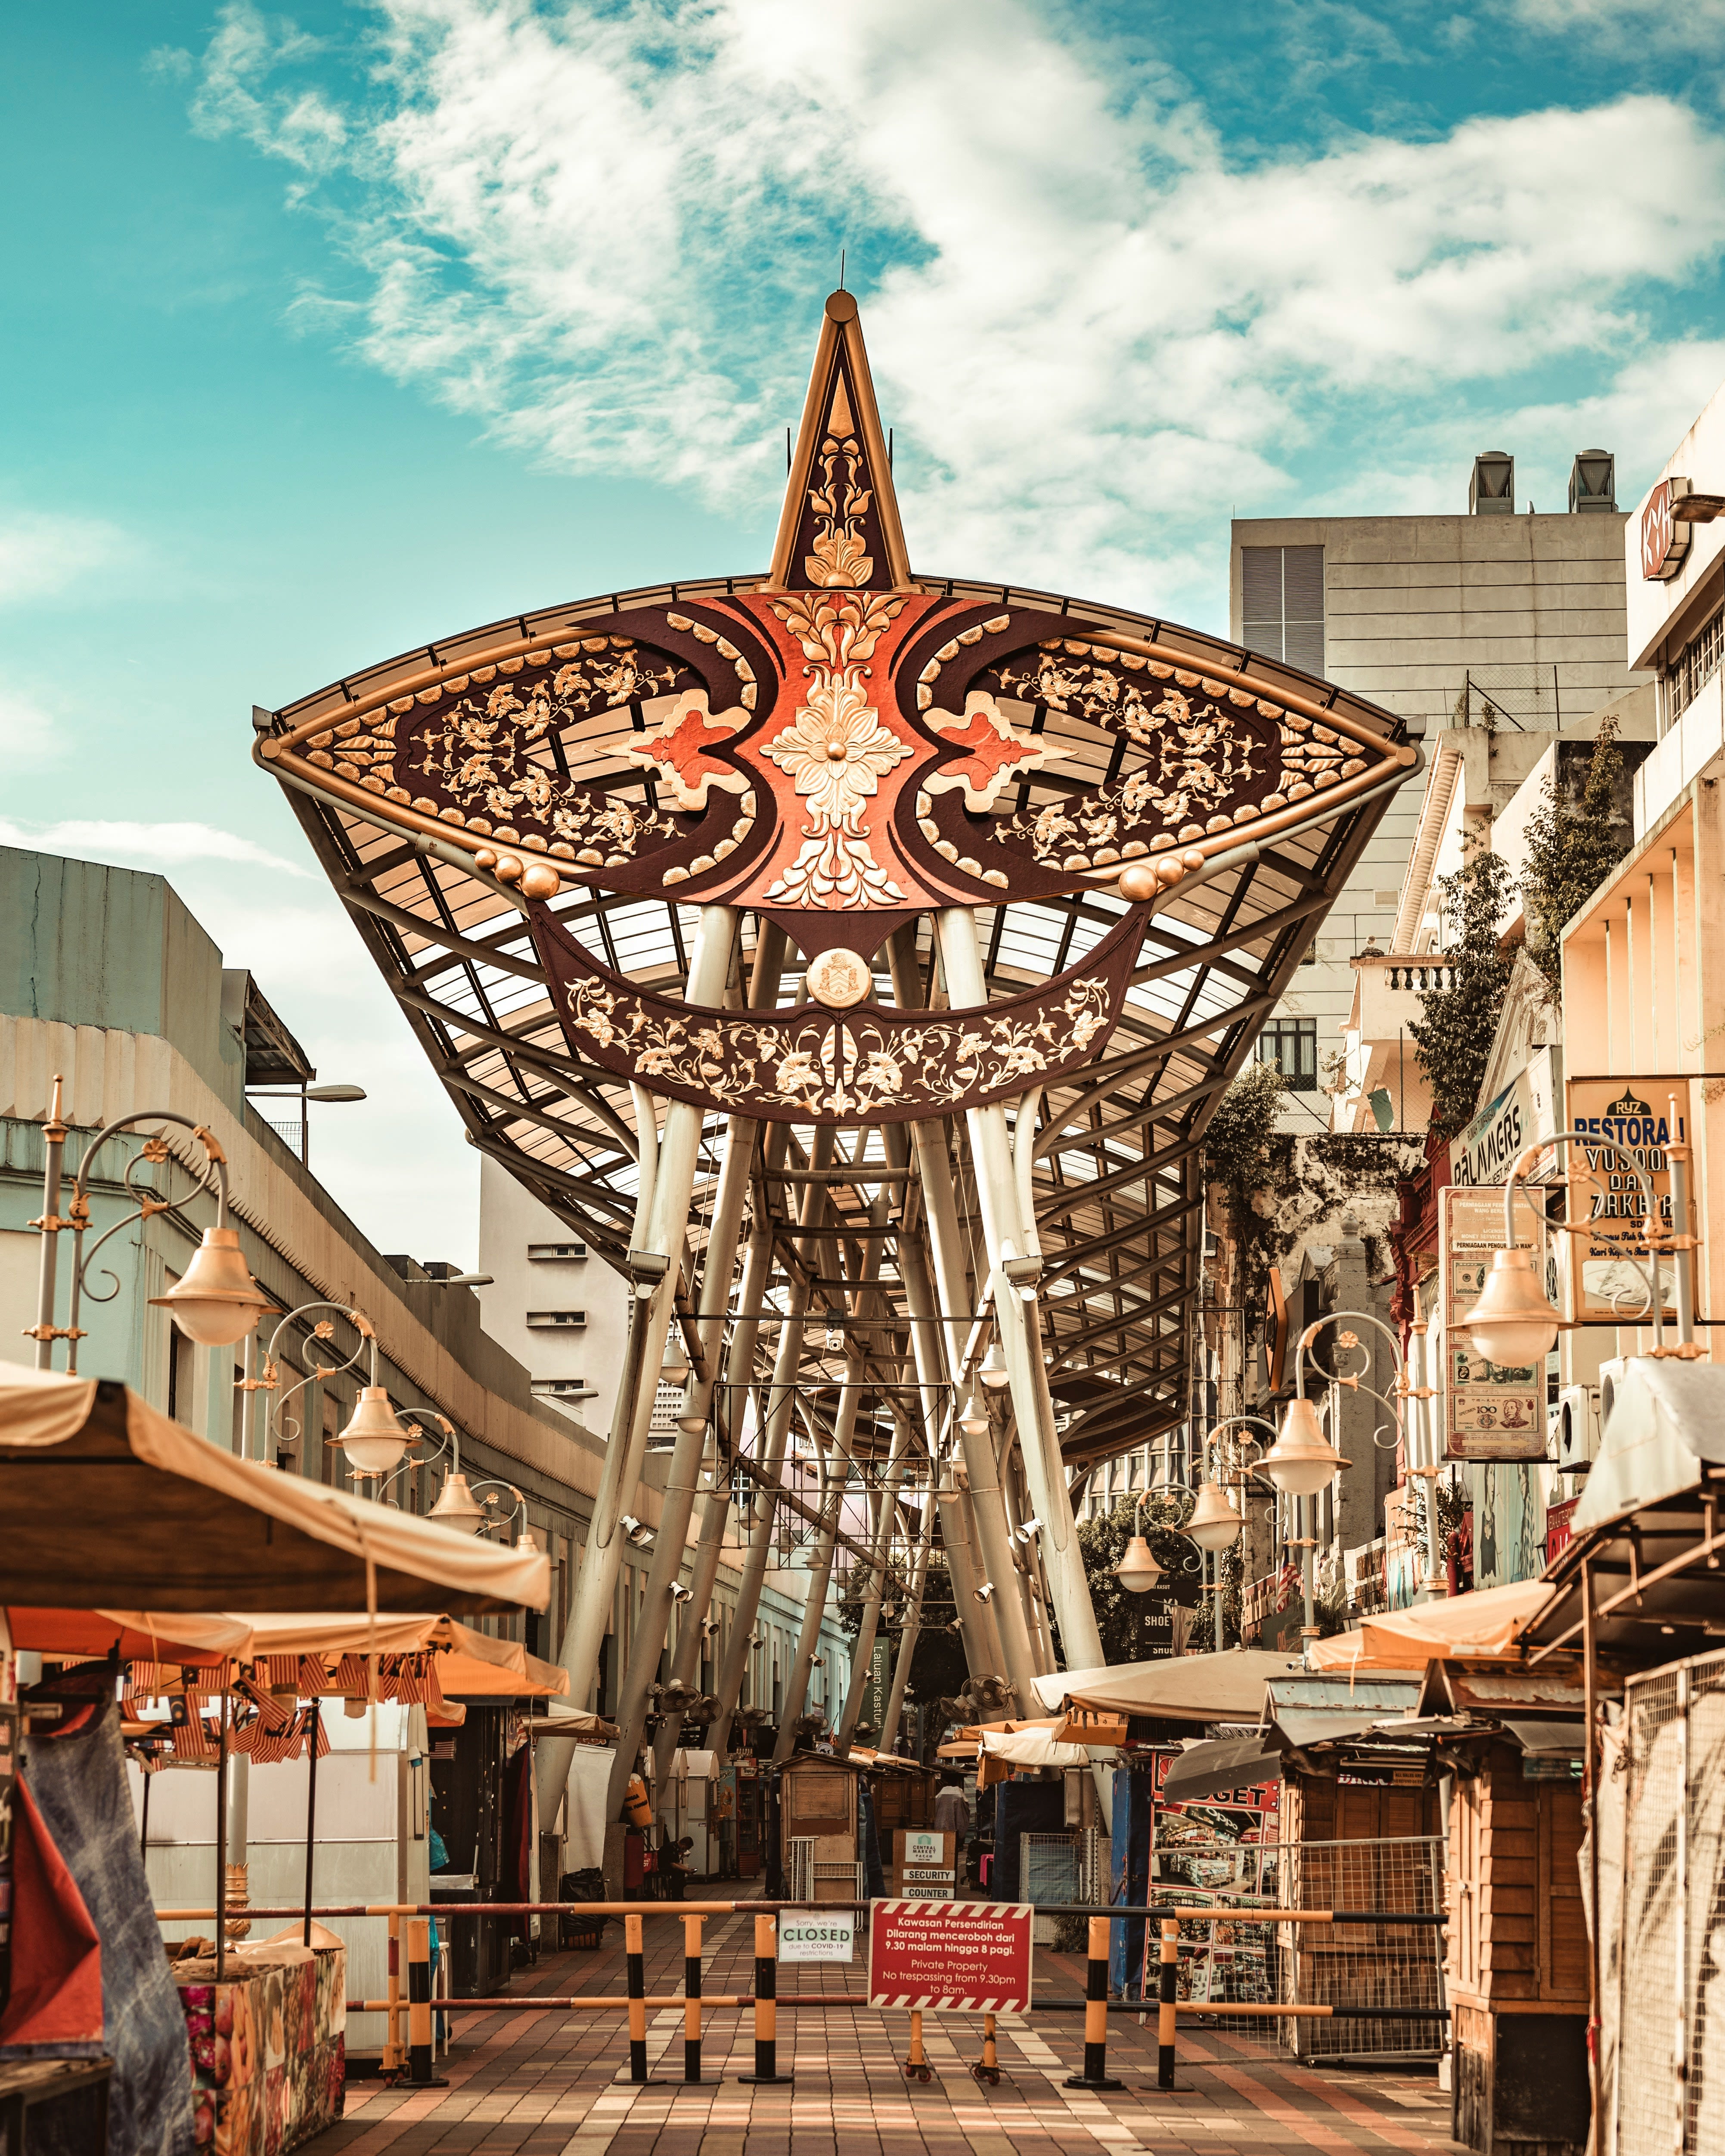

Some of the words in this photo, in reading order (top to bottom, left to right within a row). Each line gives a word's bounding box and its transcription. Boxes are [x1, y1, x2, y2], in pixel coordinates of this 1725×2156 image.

[1616, 1102, 1641, 1114] RYZ
[1590, 1248, 1607, 1256] Kari
[1459, 1407, 1476, 1416] SPECIMEN
[874, 1646, 882, 1683] Laluan
[909, 1871, 950, 1879] SECURITY
[909, 1889, 948, 1898] COUNTER
[898, 1917, 942, 1927] Kawasan
[945, 1920, 1004, 1930] Persendirian
[784, 1929, 850, 1941] CLOSED
[887, 1929, 927, 1941] Dilarang
[930, 1932, 993, 1942] menceroboh
[996, 1933, 1015, 1942] dari
[885, 1941, 905, 1951] 9.30
[908, 1942, 942, 1952] malam
[945, 1943, 979, 1955] hingga
[981, 1944, 987, 1954] 8
[990, 1945, 1015, 1956] pagi.
[912, 1959, 944, 1970] Private
[947, 1961, 988, 1973] Property
[883, 1971, 897, 1980] No
[900, 1972, 952, 1984] trespassing
[955, 1973, 977, 1983] from
[980, 1975, 1015, 1986] 9.30pm
[931, 1984, 940, 1994] to
[943, 1986, 967, 1995] 8am.
